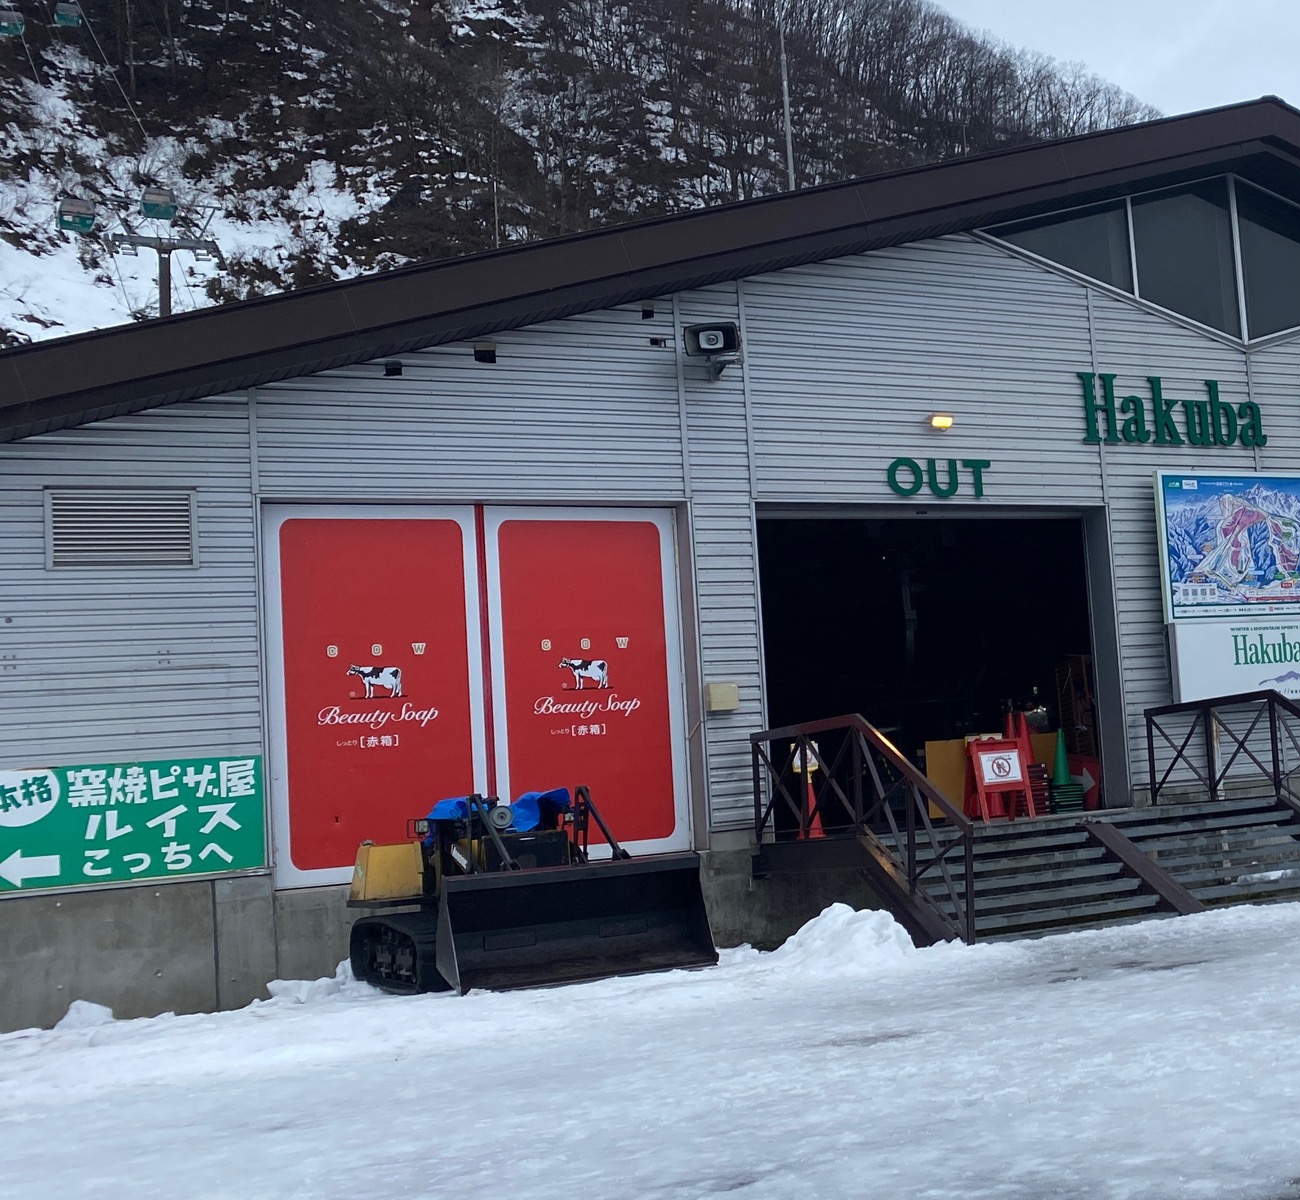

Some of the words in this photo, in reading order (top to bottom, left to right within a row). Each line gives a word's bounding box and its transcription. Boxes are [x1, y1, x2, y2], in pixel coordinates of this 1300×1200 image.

[1077, 372, 1267, 447] Hakuba
[887, 456, 991, 498] OUT
[317, 705, 391, 730] Beauty
[391, 702, 439, 727] Soap
[533, 696, 599, 719] Beauty
[599, 693, 641, 717] Soap
[66, 758, 256, 808] 窯焼ピザ屋
[85, 802, 242, 841] ルイス
[82, 841, 234, 876] こっちへ
